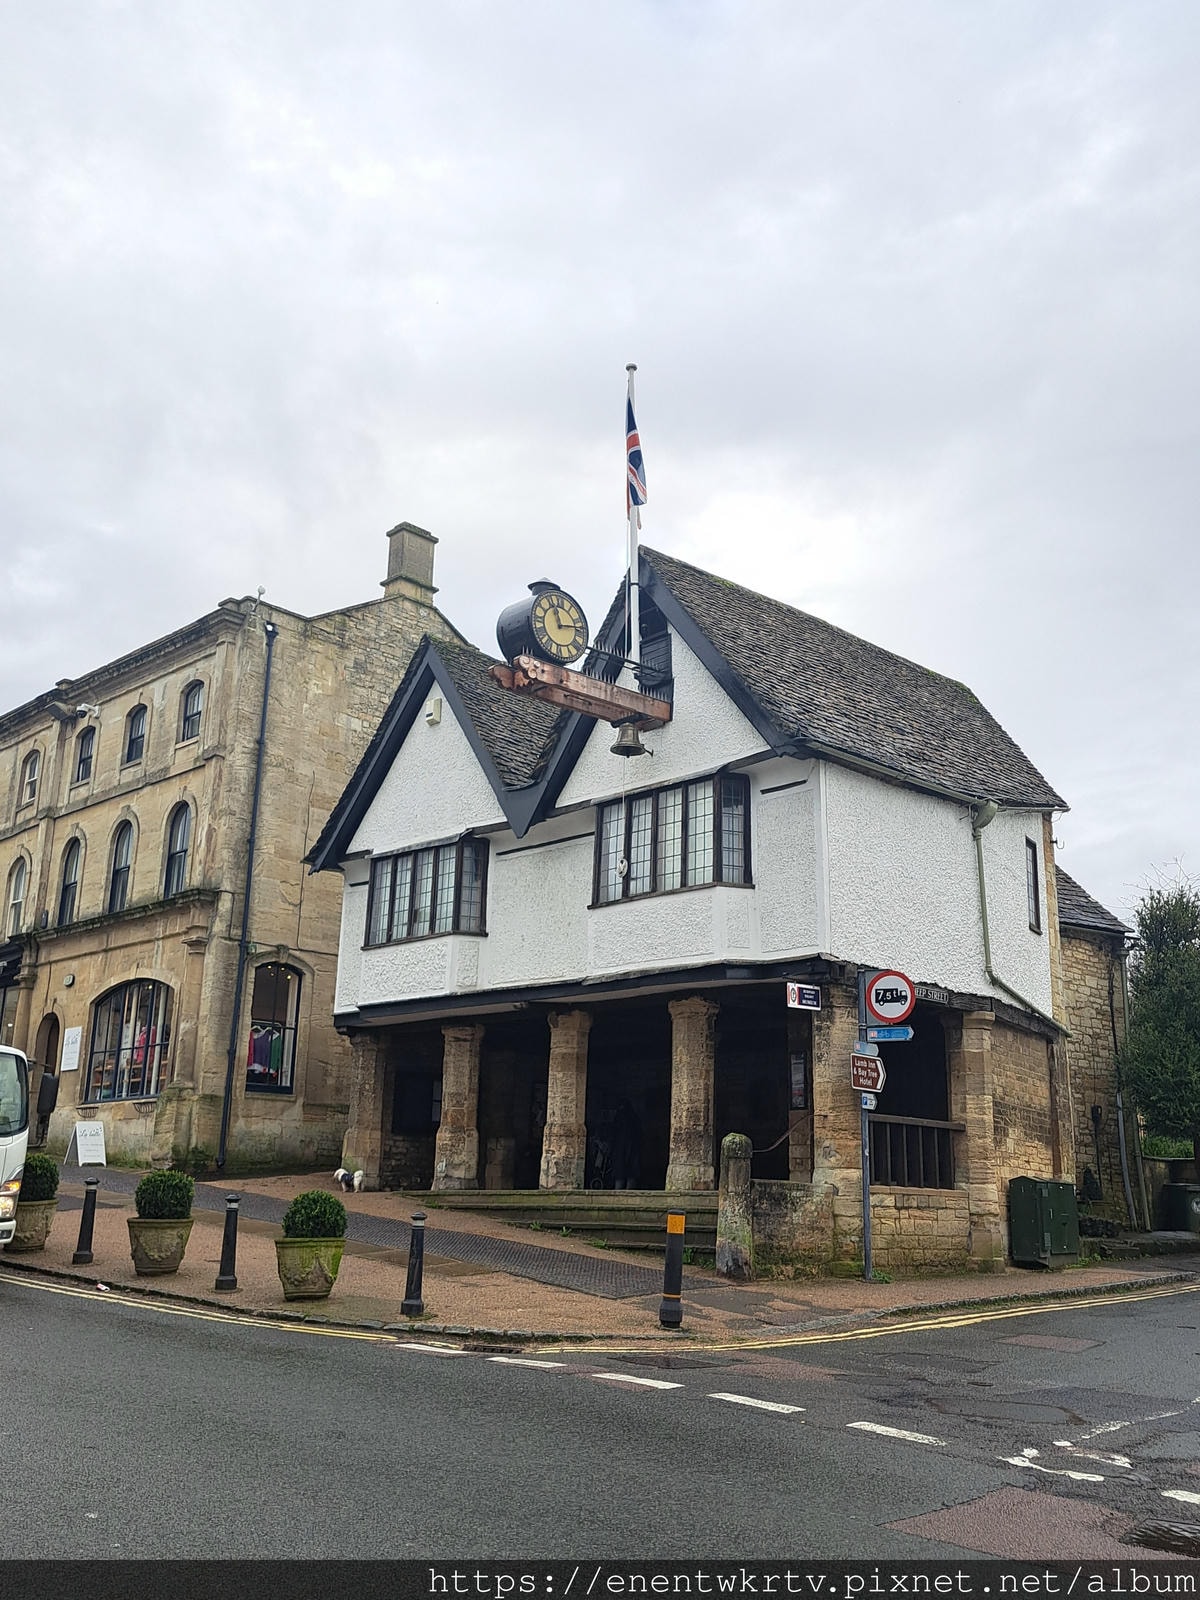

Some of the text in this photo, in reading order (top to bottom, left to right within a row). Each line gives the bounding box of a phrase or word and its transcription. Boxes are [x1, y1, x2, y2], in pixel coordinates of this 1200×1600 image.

[927, 990, 948, 1001] STREET
[854, 1058, 876, 1068] Lamb Inn
[858, 1067, 867, 1078] Bay
[867, 1069, 878, 1078] Tree
[859, 1076, 873, 1086] Hotel
